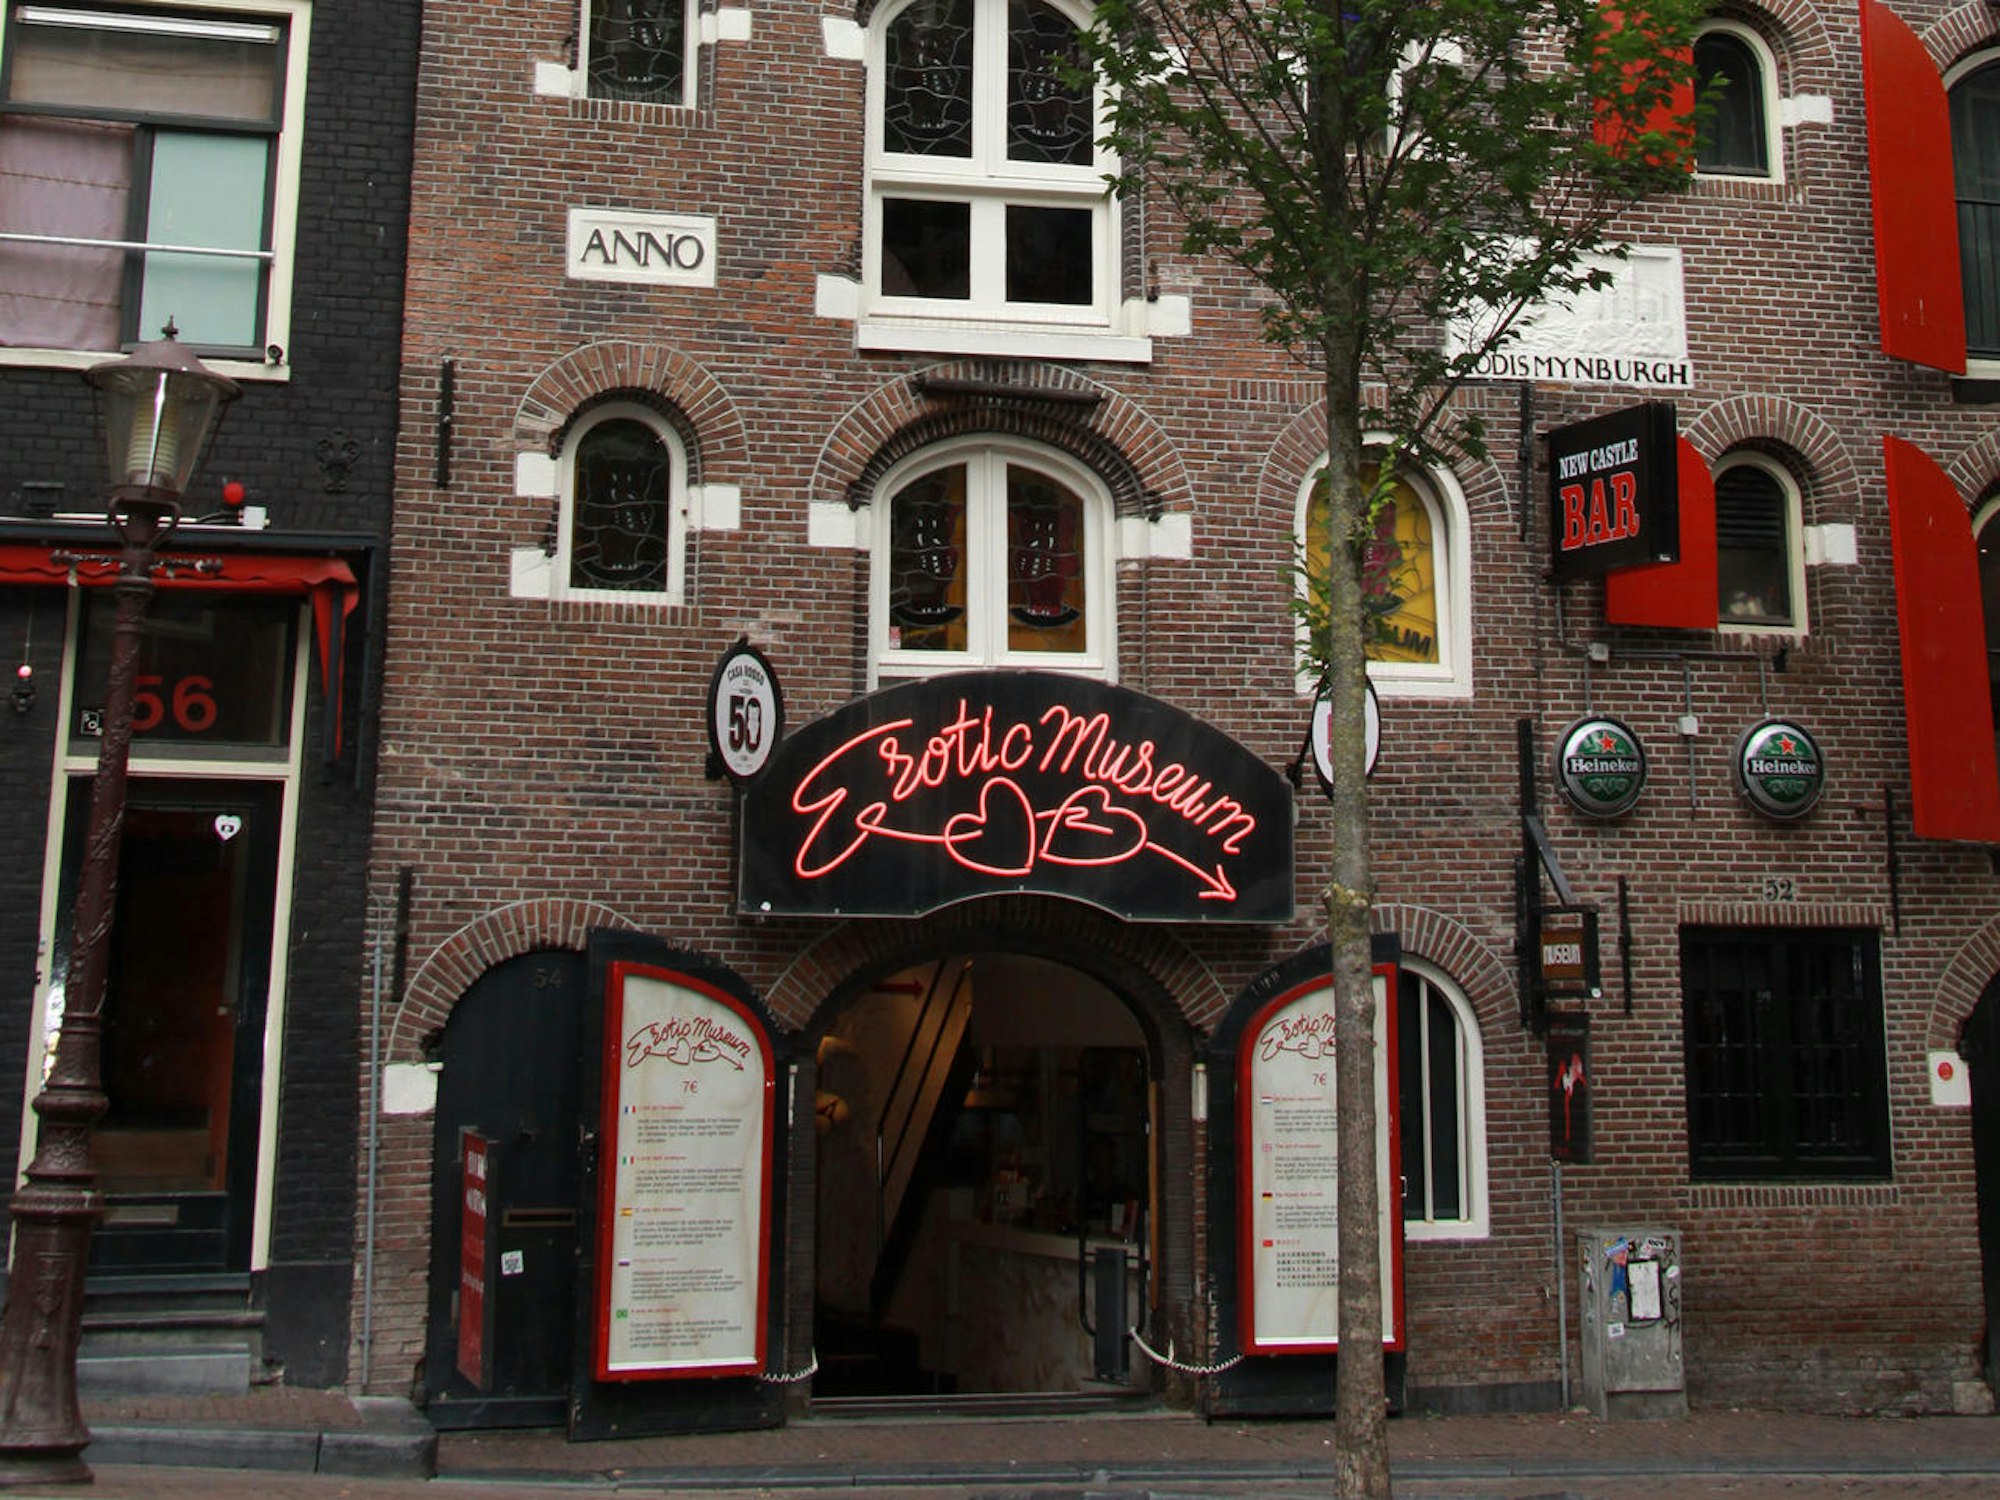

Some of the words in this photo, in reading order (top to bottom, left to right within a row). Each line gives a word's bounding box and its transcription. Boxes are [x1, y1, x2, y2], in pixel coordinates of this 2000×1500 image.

[580, 227, 705, 270] ANNO
[1559, 451, 1589, 480] NEW
[1589, 437, 1639, 472] CASTLE
[1560, 470, 1640, 551] BAR
[131, 675, 218, 732] 56
[729, 695, 762, 754] 50
[1569, 758, 1639, 774] Heineken
[1751, 759, 1817, 775] Heineken
[793, 699, 1034, 878] Erotic
[1039, 705, 1256, 854] Museum
[1764, 878, 1794, 901] 52
[693, 1015, 751, 1058] Museum
